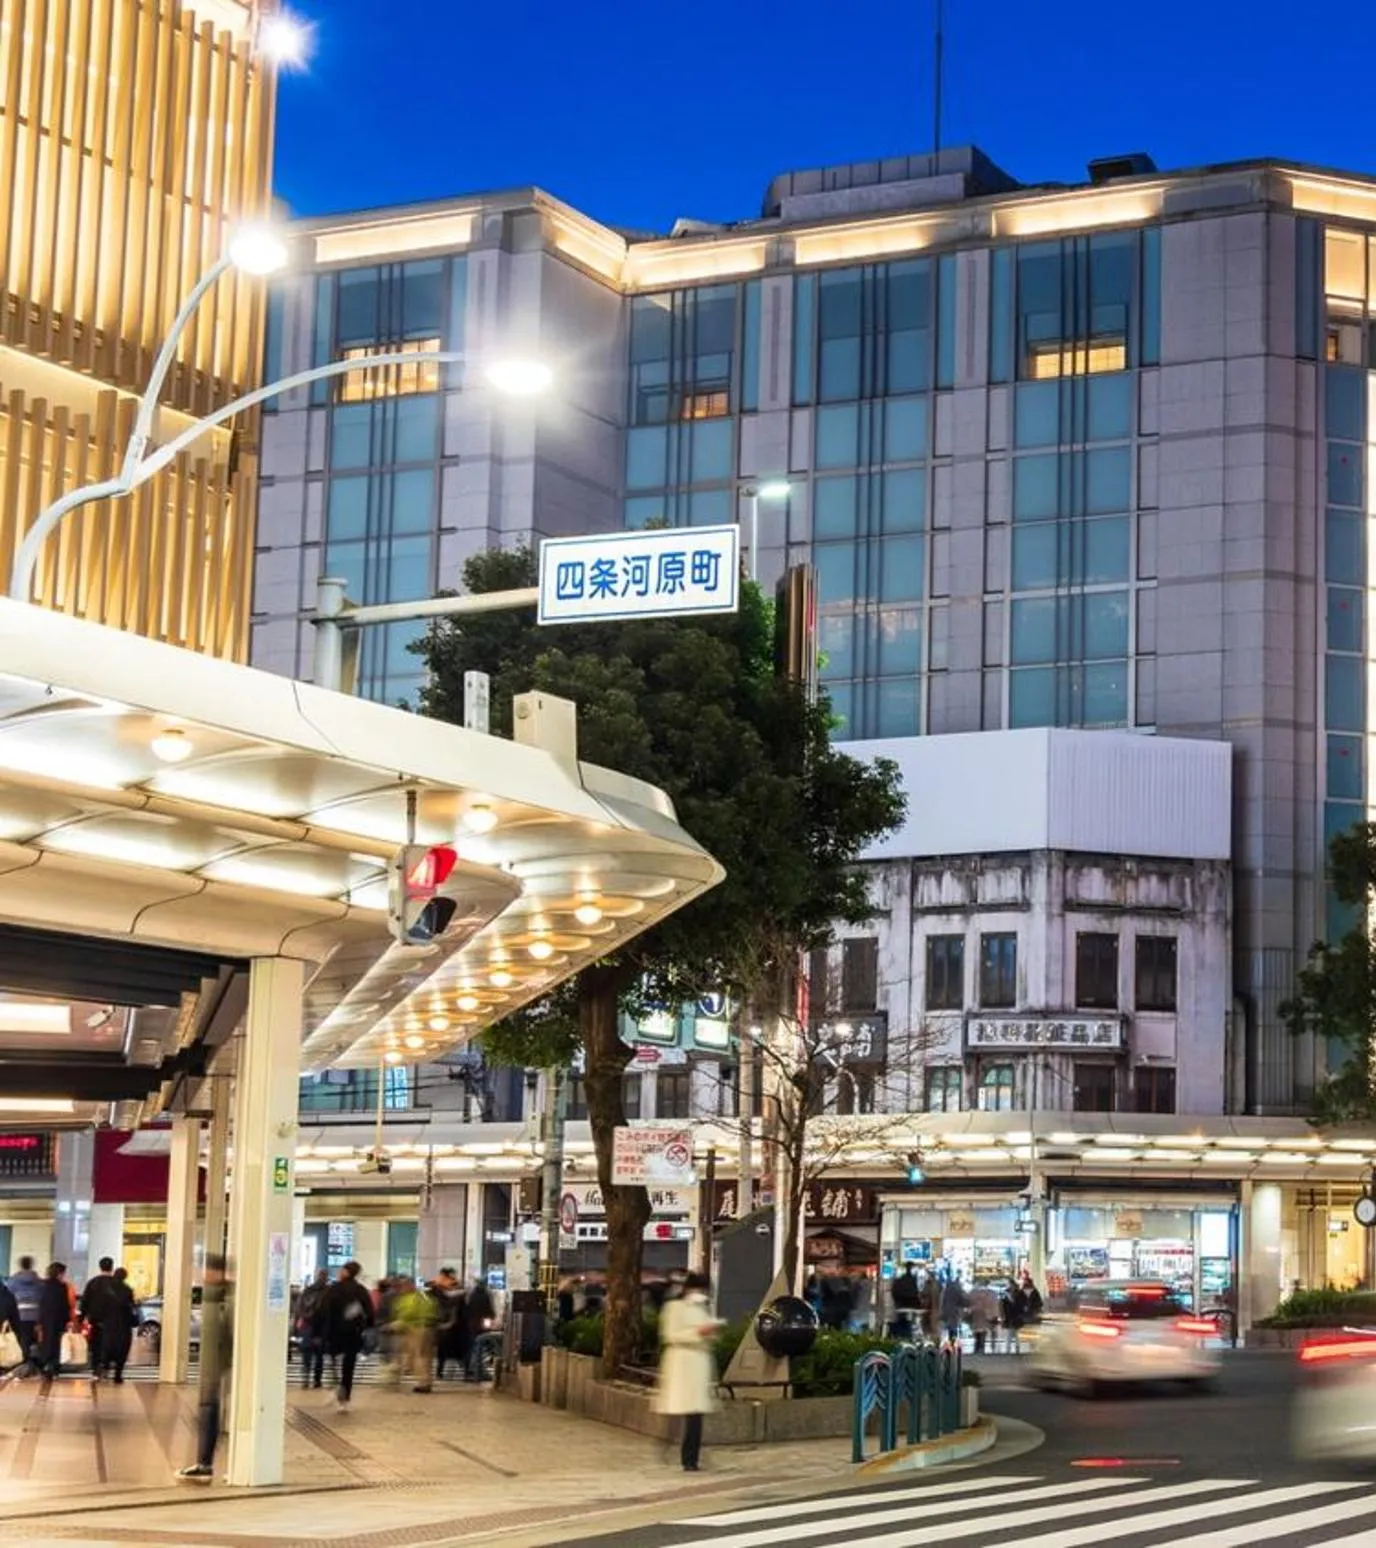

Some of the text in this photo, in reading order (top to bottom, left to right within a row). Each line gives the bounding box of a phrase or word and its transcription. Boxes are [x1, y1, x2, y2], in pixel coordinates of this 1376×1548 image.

[556, 550, 722, 600] 四条河原町
